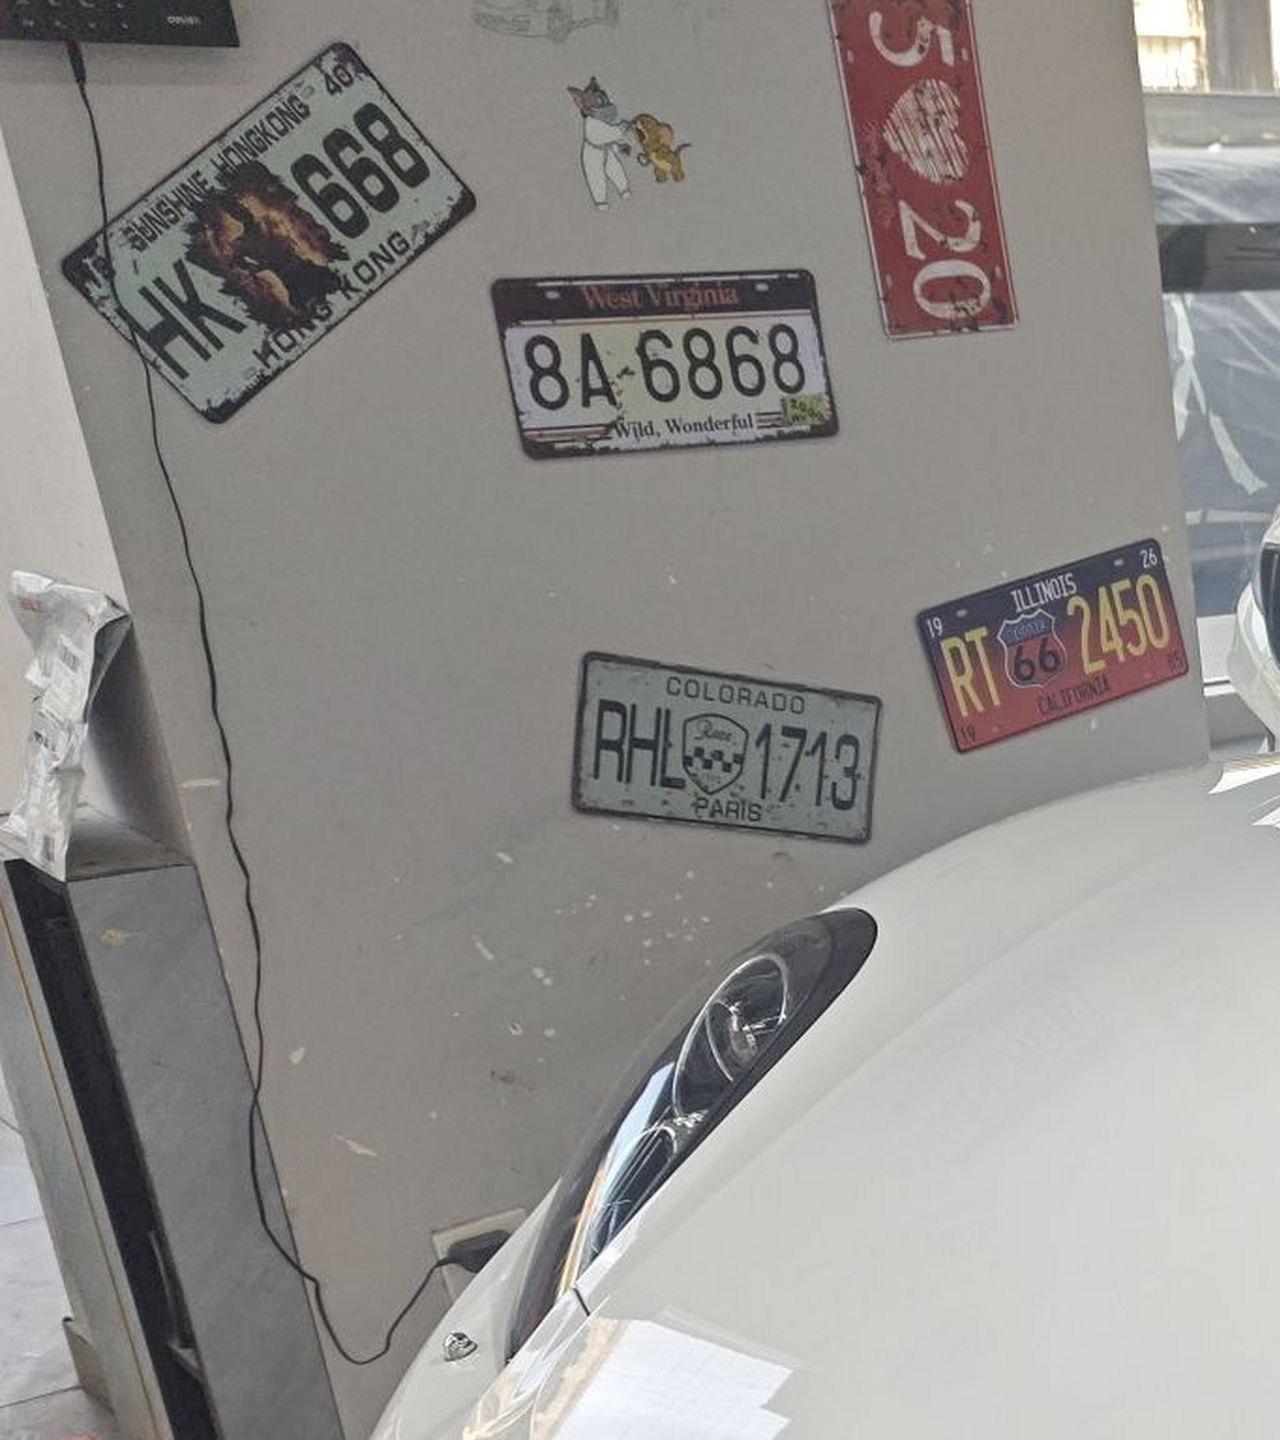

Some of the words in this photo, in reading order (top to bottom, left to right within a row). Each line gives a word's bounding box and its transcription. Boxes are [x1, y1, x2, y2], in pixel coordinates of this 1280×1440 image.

[208, 94, 312, 184] HONGKONG
[115, 258, 247, 381] HK
[290, 101, 431, 240] 668
[898, 199, 992, 320] 20
[252, 300, 333, 368] HONG
[339, 231, 411, 300] KONG
[581, 285, 642, 310] West
[651, 280, 738, 312] Virginia
[612, 418, 661, 442] Wild,
[664, 412, 754, 437] Wonderful
[1139, 549, 1158, 568] 26
[1010, 572, 1077, 613] ILLINOIS
[926, 617, 943, 638] 19
[940, 626, 1000, 717] RT
[1067, 574, 1170, 675] 2450
[1013, 636, 1062, 681] 66
[665, 676, 806, 715] COLORADO
[594, 699, 686, 790] RHL
[755, 722, 861, 811] 1713
[694, 796, 763, 823] PARIS
